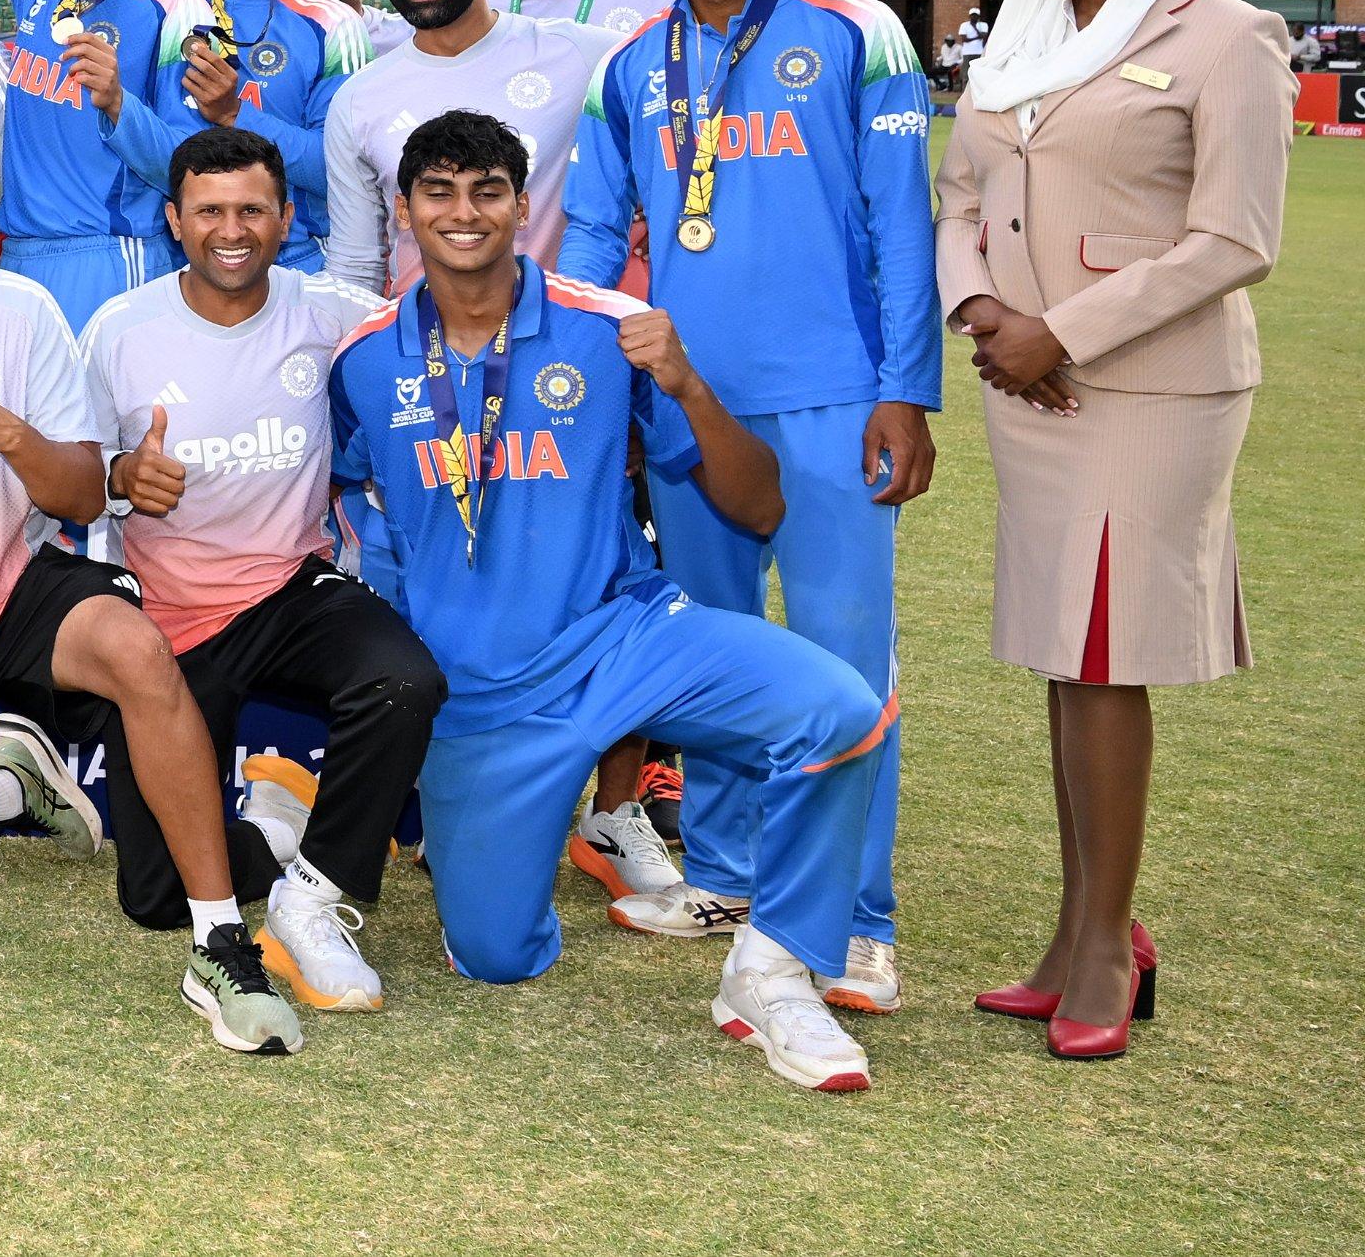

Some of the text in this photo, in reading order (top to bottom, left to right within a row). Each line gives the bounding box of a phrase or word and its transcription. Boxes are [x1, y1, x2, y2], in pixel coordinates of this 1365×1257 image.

[671, 21, 681, 62] WINNER
[786, 94, 808, 103] U-19
[658, 110, 808, 171] IDIA
[1322, 124, 1363, 137] Emirates
[494, 312, 510, 354] INNER
[391, 413, 418, 424] WORLD
[418, 410, 435, 419] CUP
[551, 416, 574, 426] U-19
[173, 416, 307, 473] apollo
[222, 449, 304, 476] TYRES
